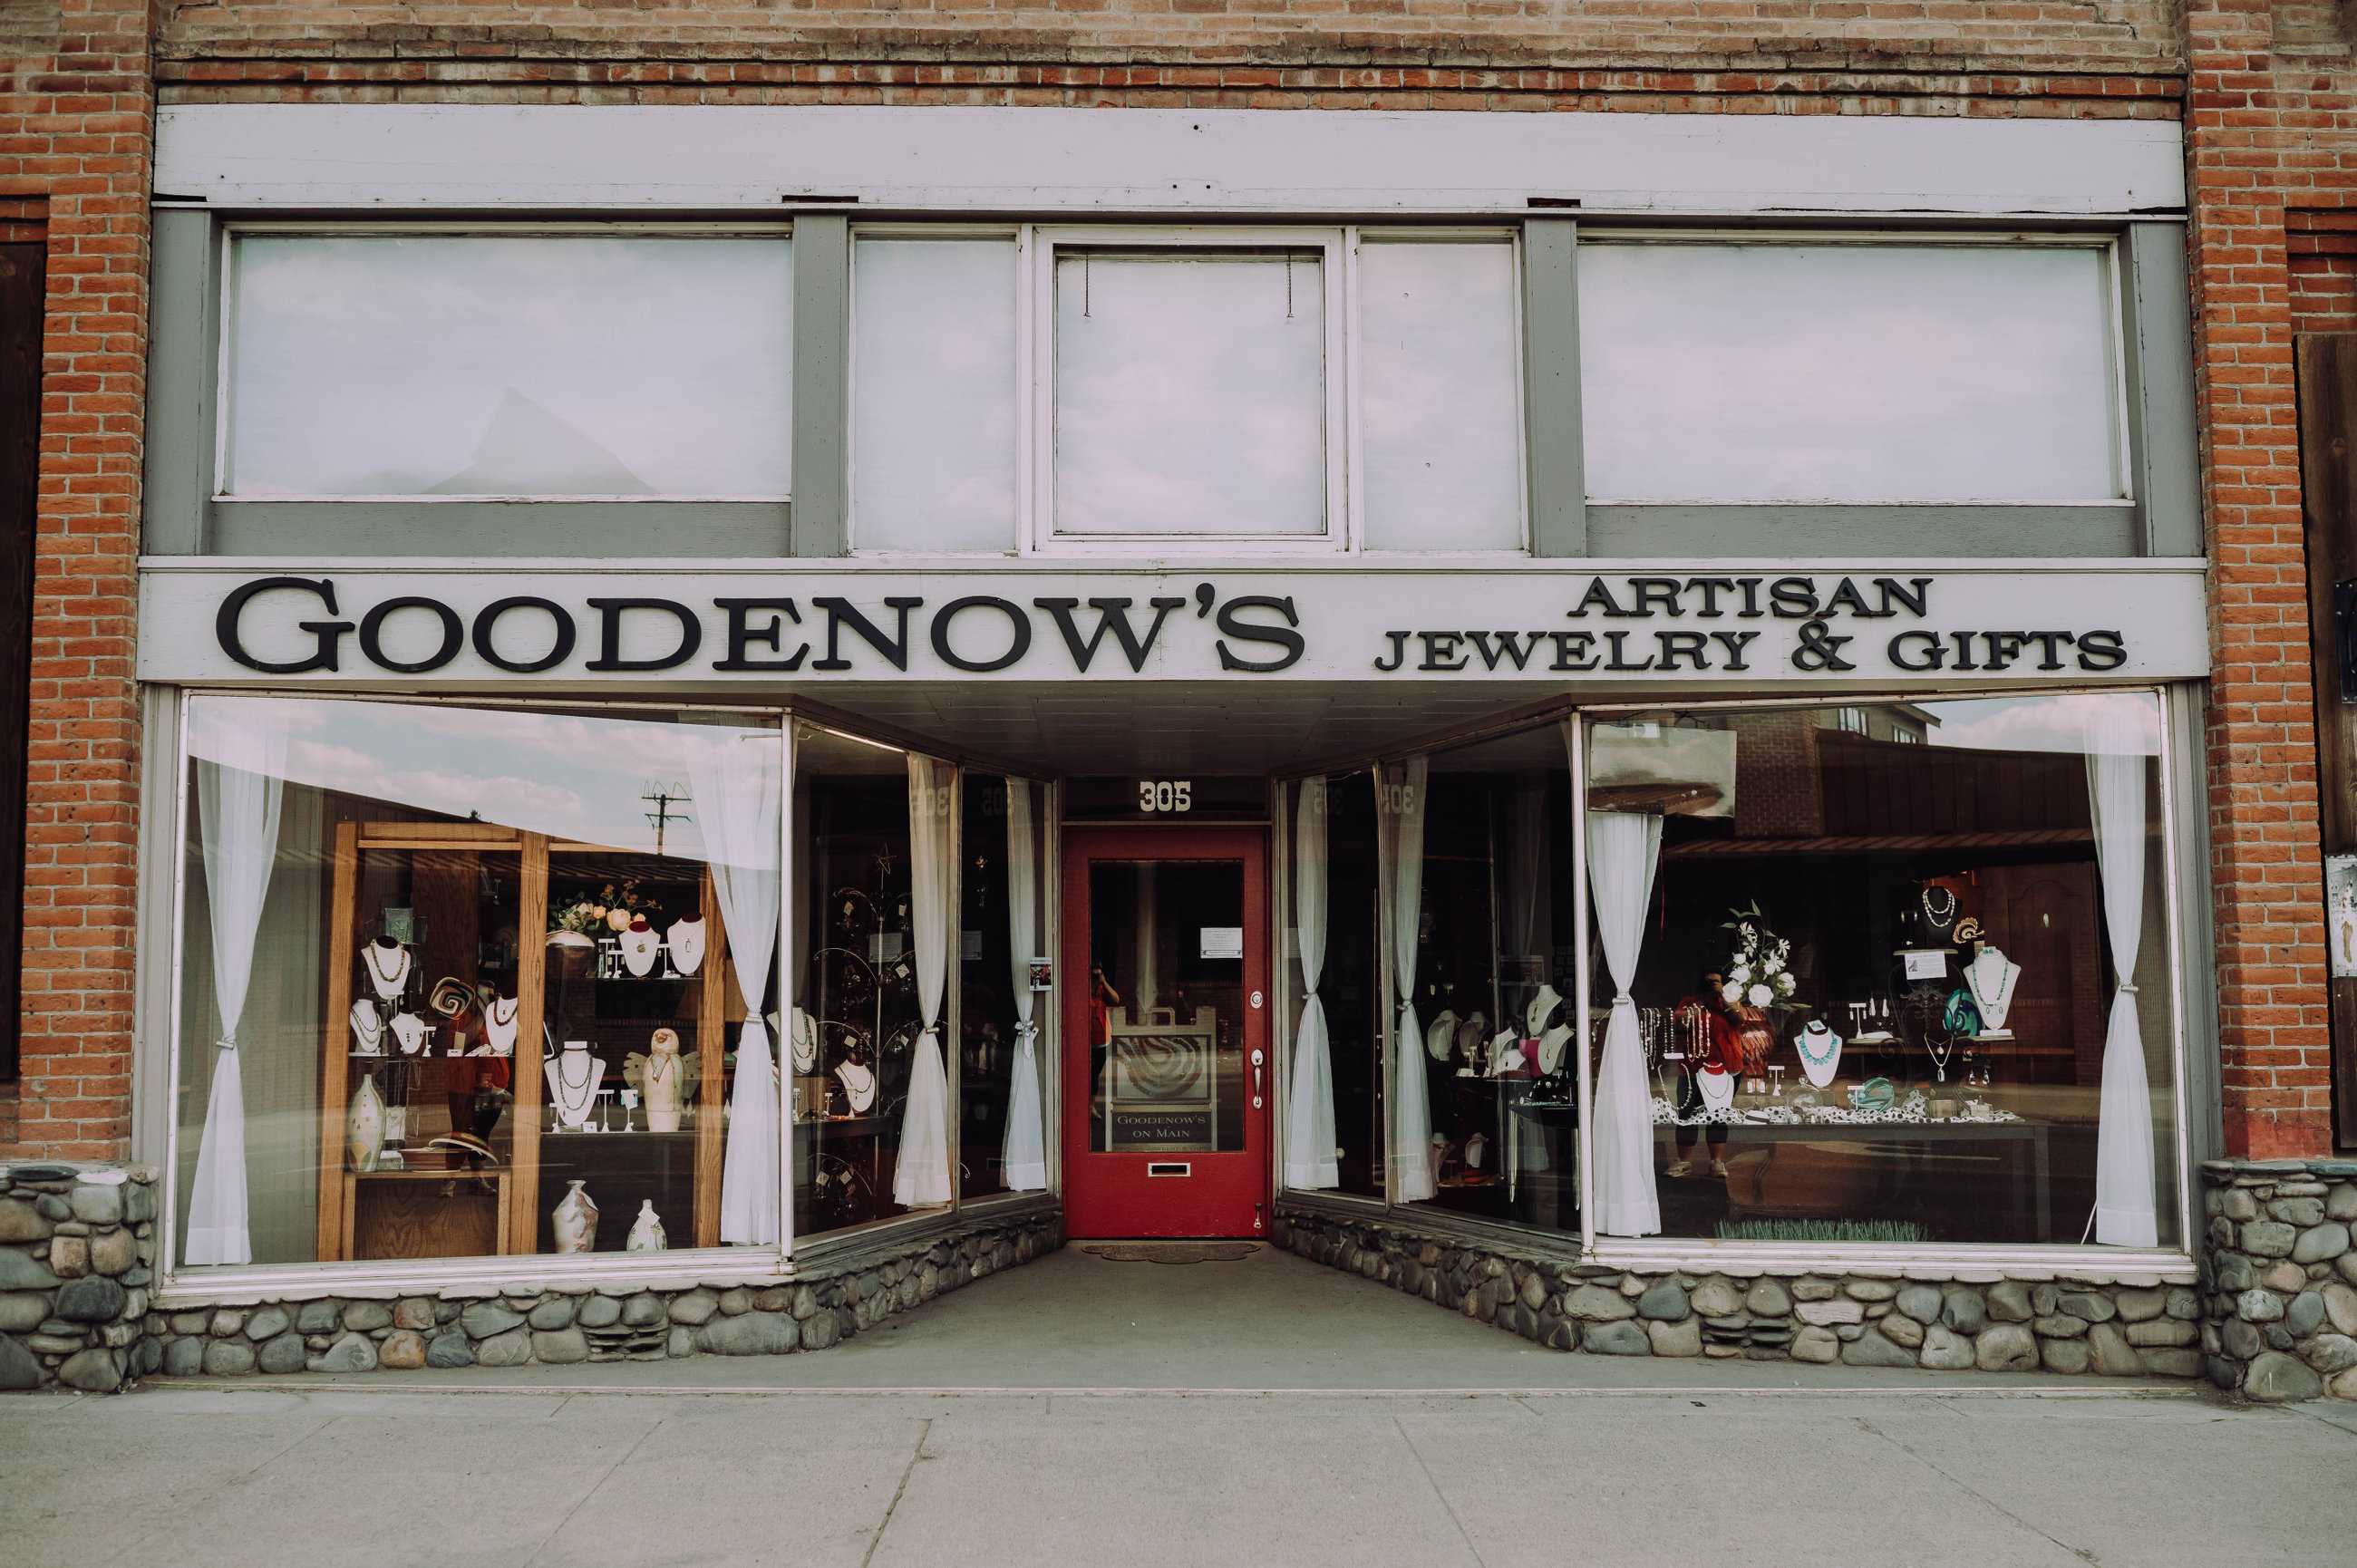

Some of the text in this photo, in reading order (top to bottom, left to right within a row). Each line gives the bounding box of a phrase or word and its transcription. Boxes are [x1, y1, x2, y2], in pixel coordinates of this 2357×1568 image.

[1566, 576, 1934, 618] ARTISAN
[216, 576, 1305, 674] GOODENOW'S
[1373, 619, 2128, 672] JEWELRY & GIFTS
[1140, 780, 1191, 812] 305
